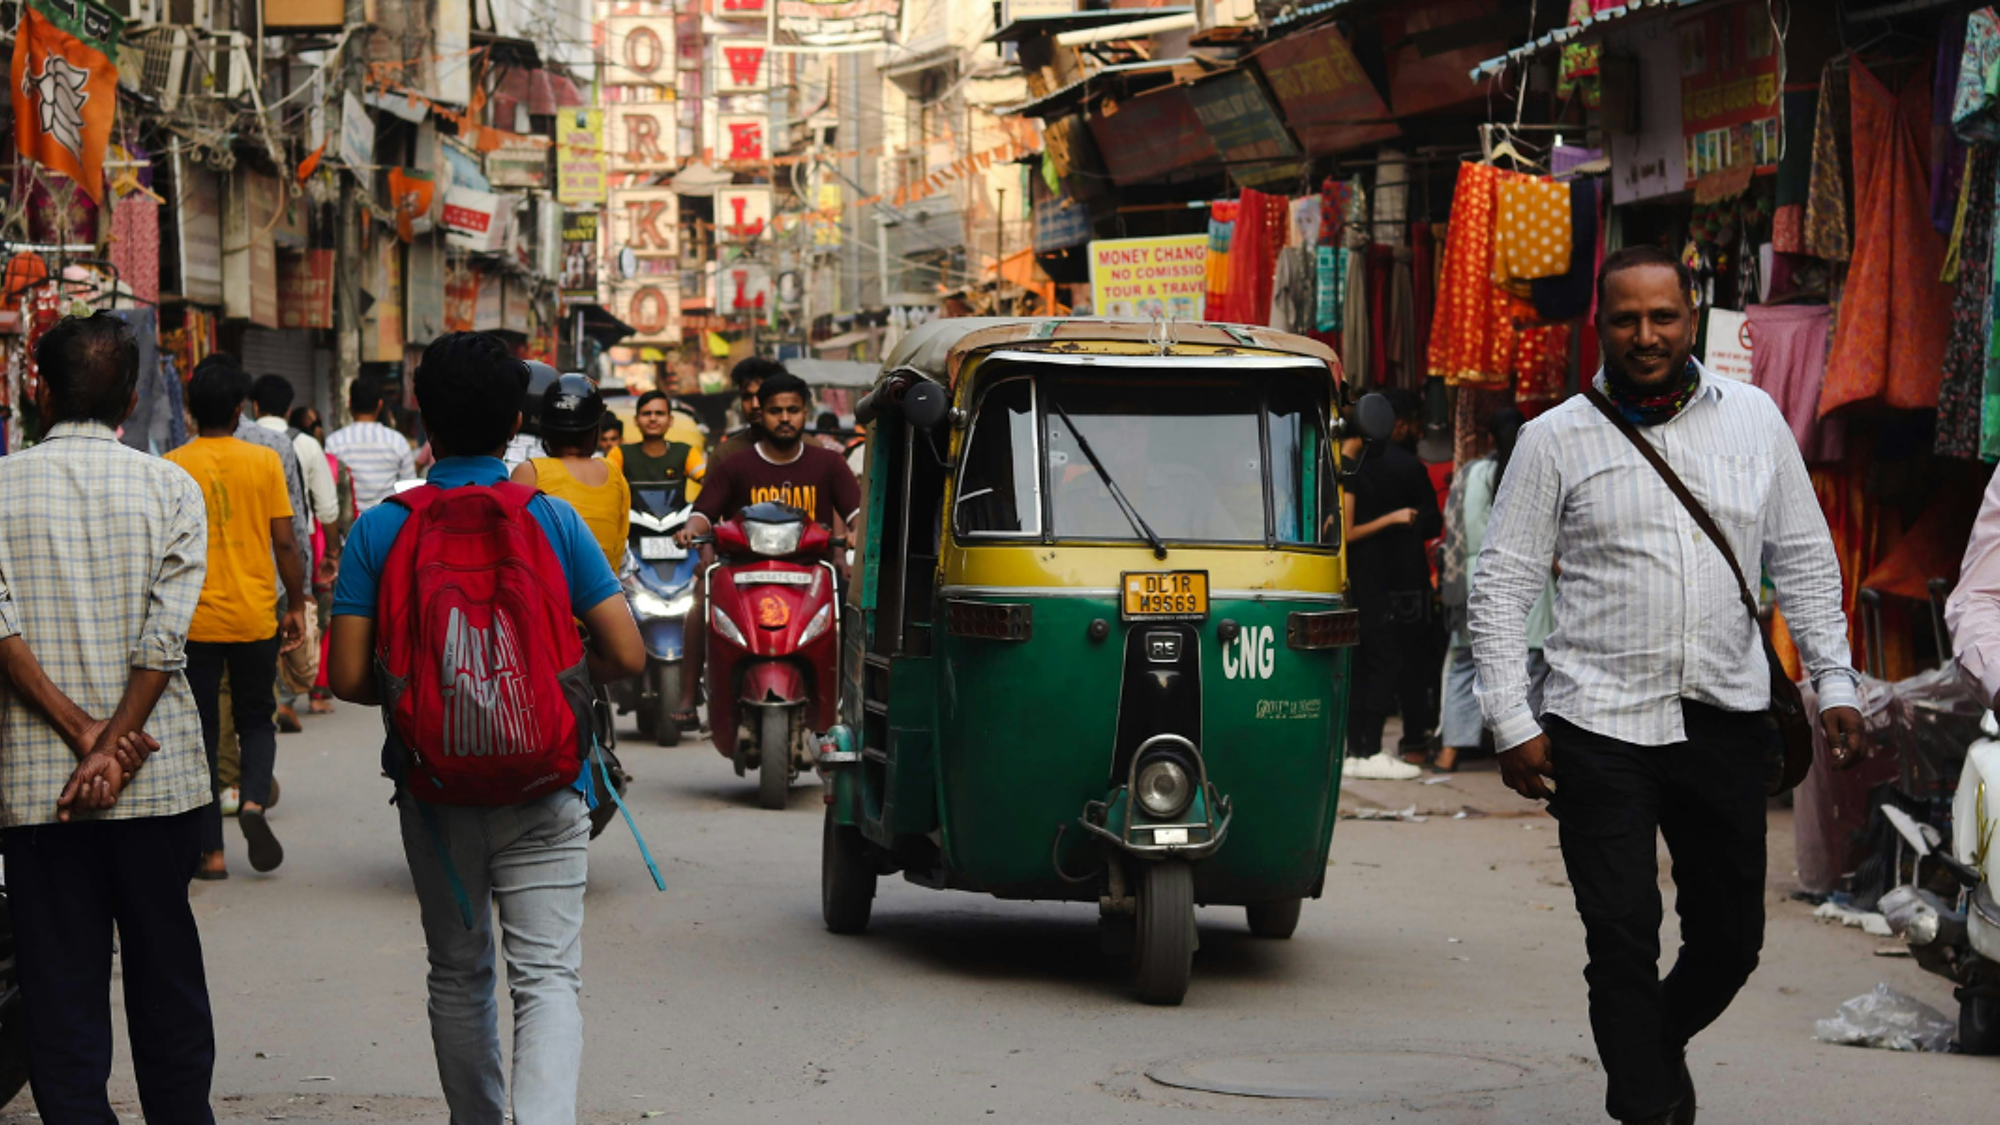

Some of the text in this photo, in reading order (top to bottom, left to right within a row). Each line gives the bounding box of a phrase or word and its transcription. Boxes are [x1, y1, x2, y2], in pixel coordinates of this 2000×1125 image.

[1098, 248, 1149, 266] MONEY
[1111, 268, 1131, 281] NO
[1104, 282, 1142, 298] TOUR
[1147, 282, 1156, 295] &
[1152, 642, 1175, 655] RE
[1222, 625, 1274, 680] CNG
